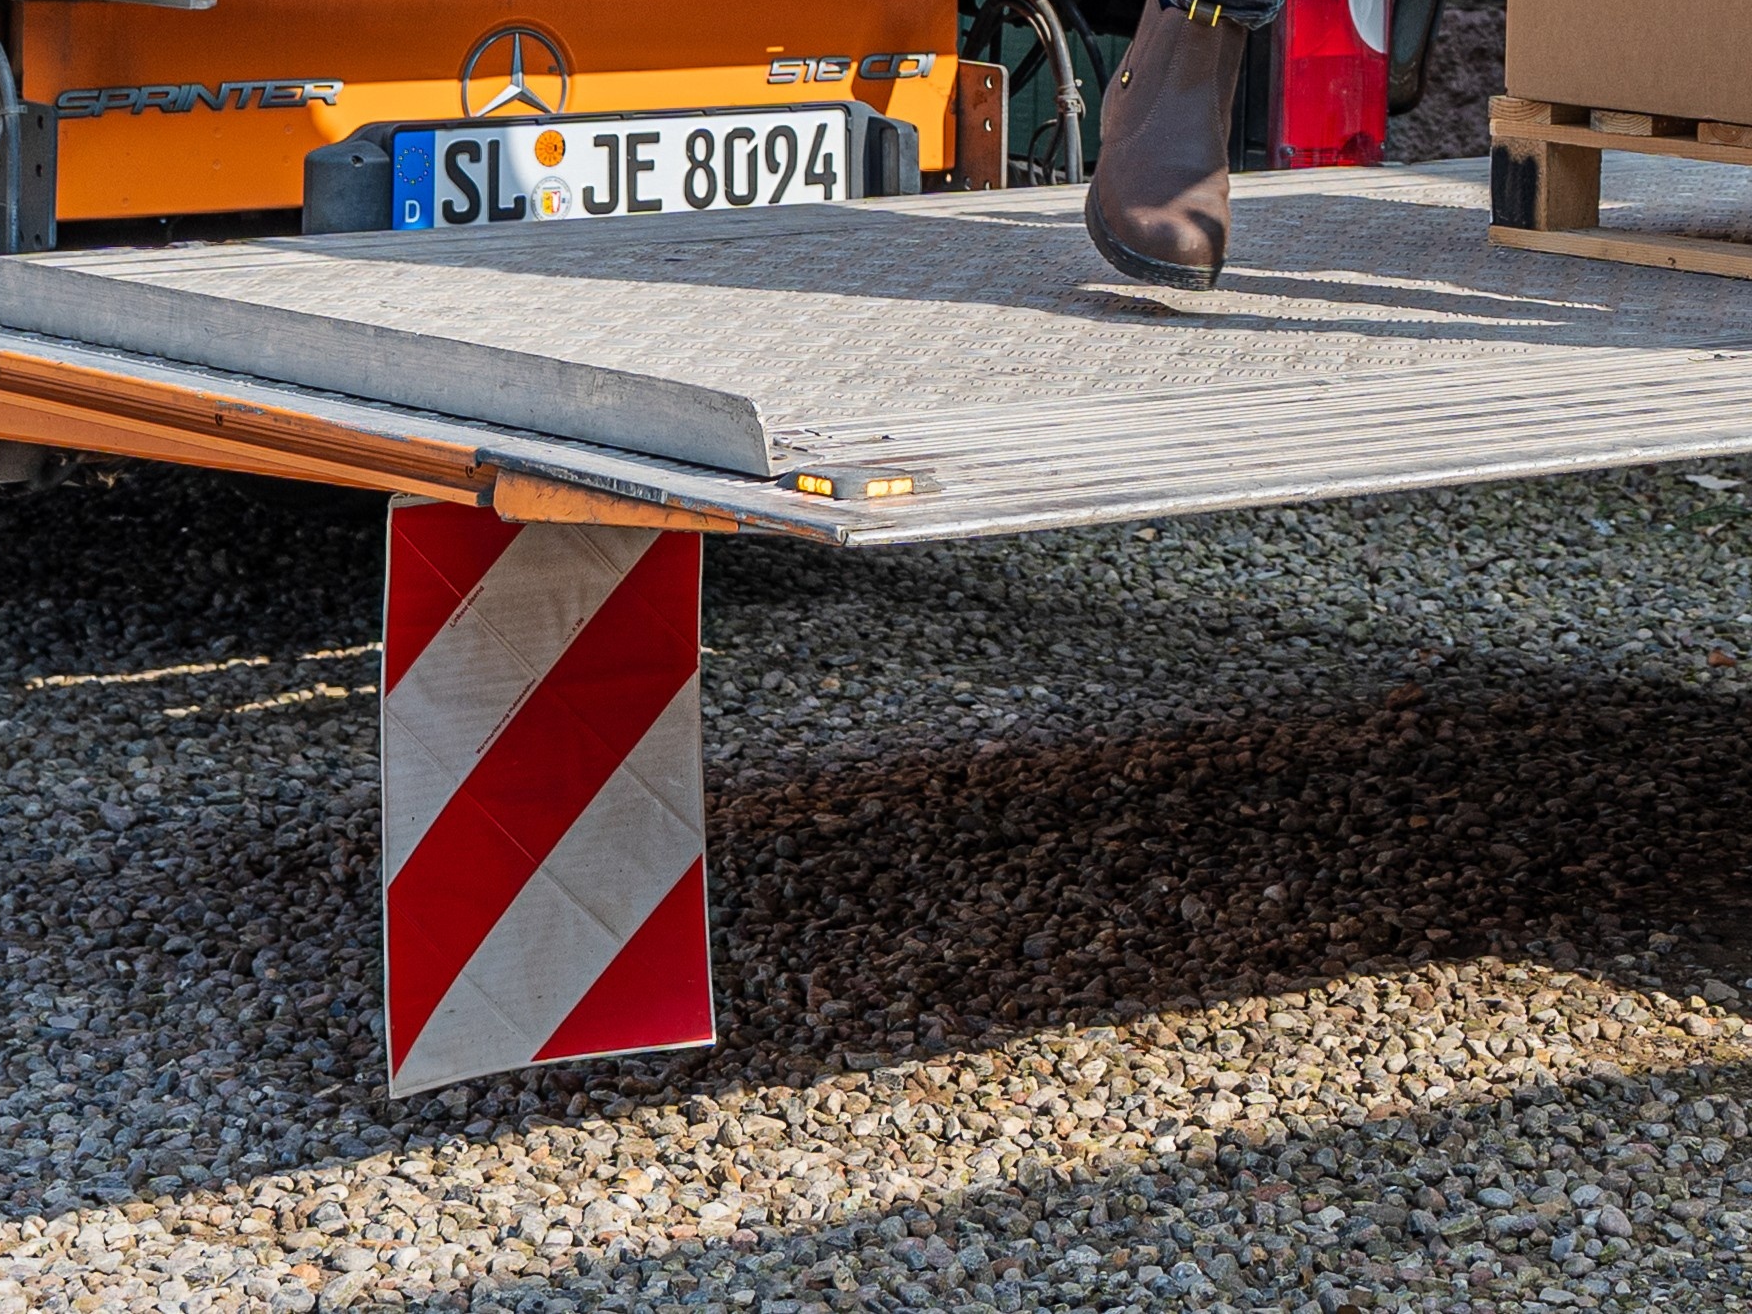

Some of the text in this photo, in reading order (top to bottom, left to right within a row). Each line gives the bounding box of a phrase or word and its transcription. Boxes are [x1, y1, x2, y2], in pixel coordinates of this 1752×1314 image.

[767, 52, 937, 85] 516 CDI
[55, 77, 345, 120] SPRINTER
[441, 139, 526, 225] SL
[582, 130, 663, 217] JE
[684, 122, 837, 210] 8094
[404, 199, 421, 224] D
